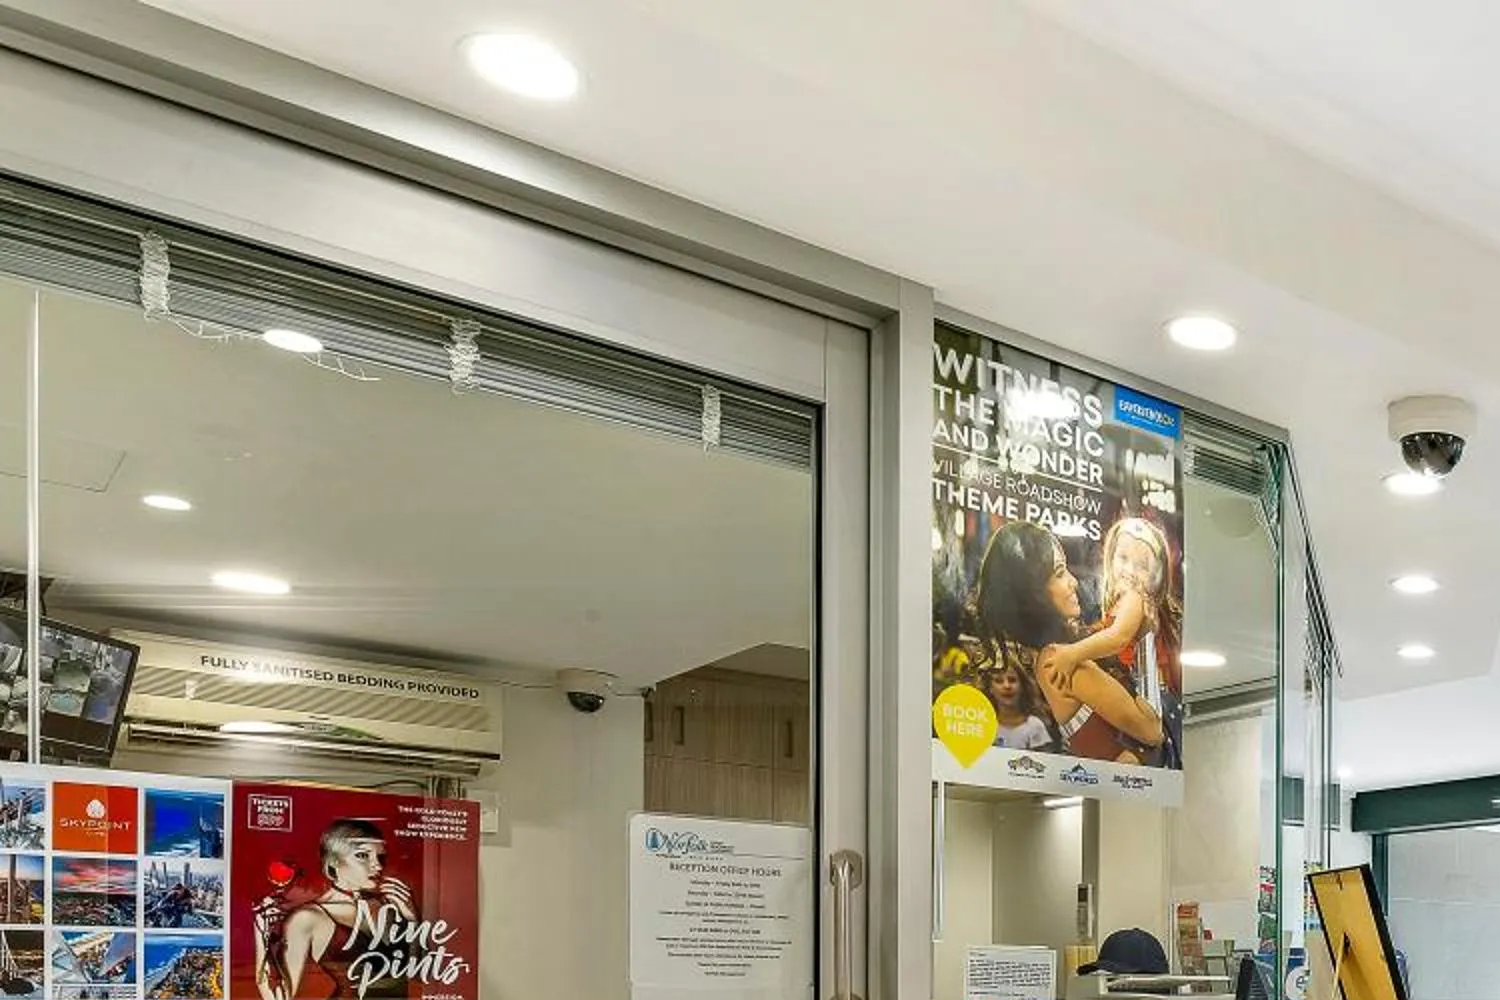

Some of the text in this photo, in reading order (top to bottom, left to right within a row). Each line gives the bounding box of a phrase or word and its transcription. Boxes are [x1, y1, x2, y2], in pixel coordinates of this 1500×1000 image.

[932, 383, 996, 426] THE
[933, 343, 1103, 429] WITNESS
[932, 418, 1103, 485] AND WONDER
[932, 459, 1102, 516] VILLAGE ROADSHOW
[932, 478, 1102, 541] THEME PARKS
[201, 655, 249, 671] FULLY
[337, 673, 405, 691] BEDDING
[407, 681, 480, 700] PROVIDED
[943, 702, 988, 722] BOOK
[946, 721, 986, 738] HERE
[669, 862, 719, 874] RECEPTION
[342, 899, 458, 951] Nine
